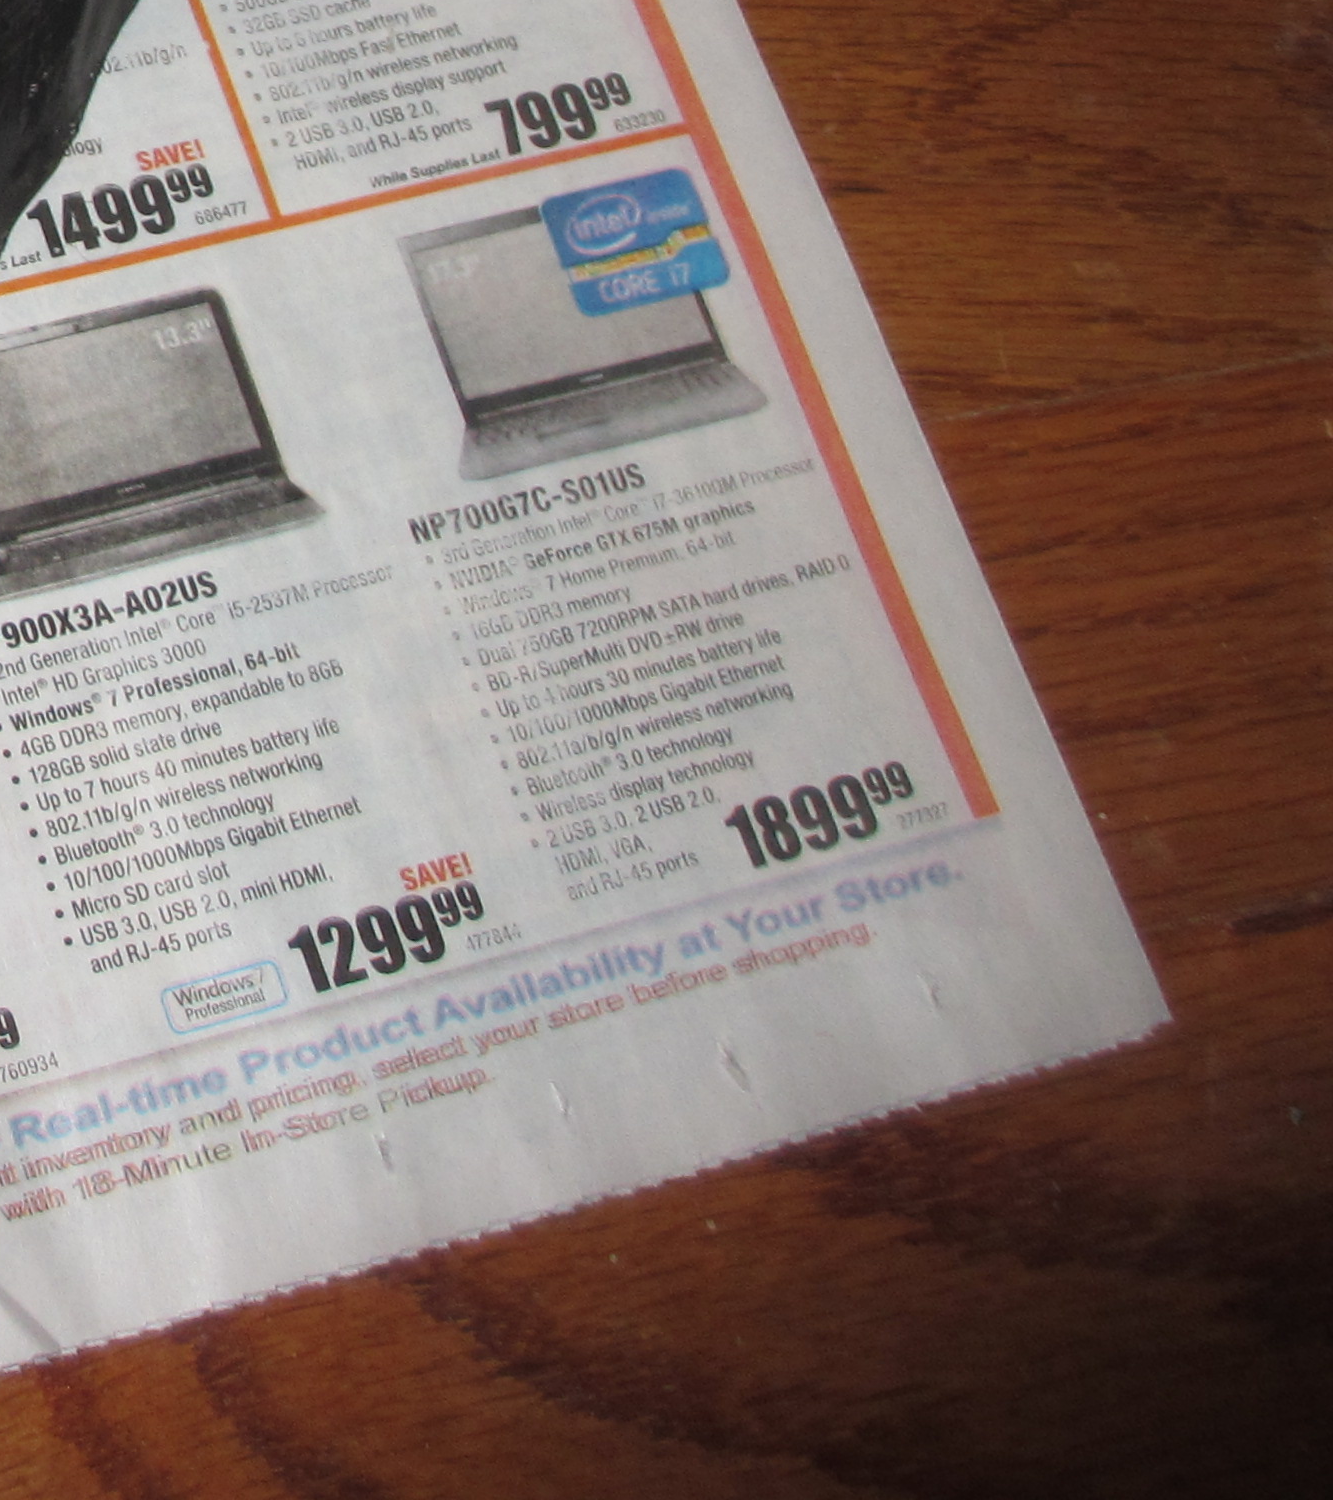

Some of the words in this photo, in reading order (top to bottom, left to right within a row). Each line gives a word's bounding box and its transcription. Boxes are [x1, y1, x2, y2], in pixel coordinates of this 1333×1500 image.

[135, 140, 205, 173] SAVE!
[72, 895, 121, 919] Micro
[124, 883, 149, 904] SD
[154, 871, 193, 896] card
[198, 862, 230, 884] slot
[398, 853, 473, 893] SAVE!
[239, 1017, 429, 1086] Product
[437, 947, 665, 1037] Availability
[678, 930, 717, 963] at
[727, 889, 827, 950] Your
[835, 854, 964, 919] Store.
